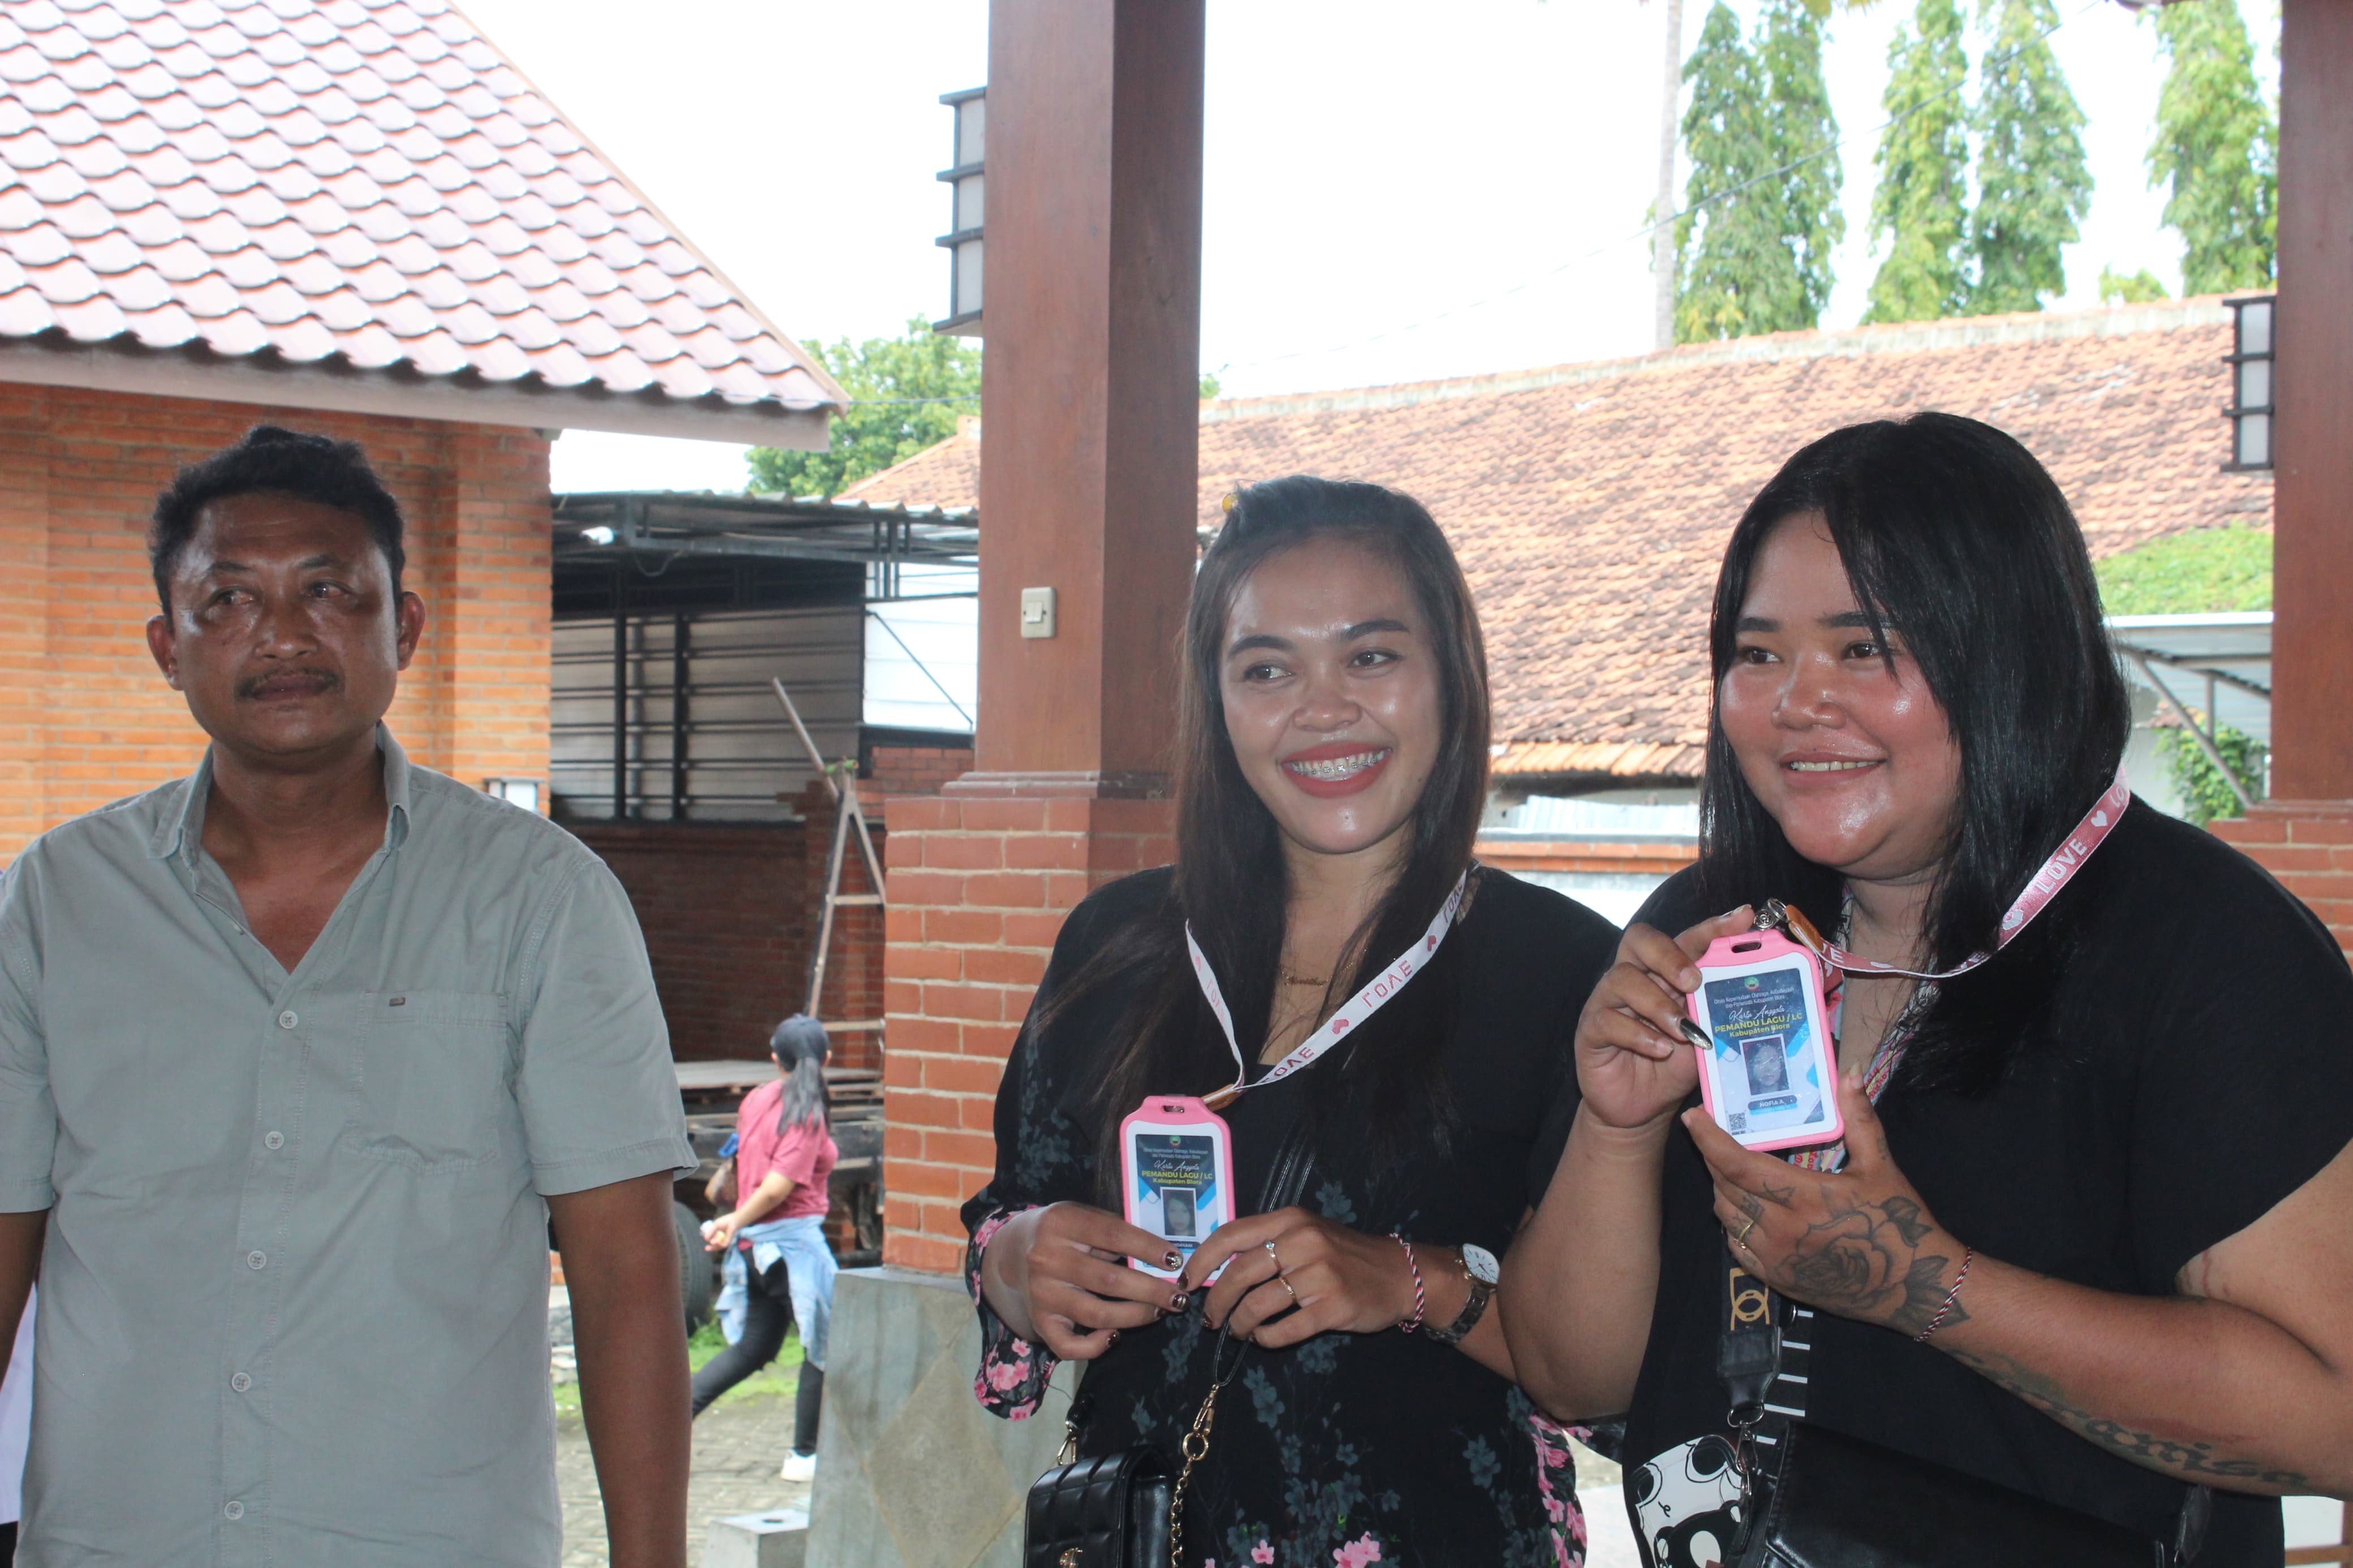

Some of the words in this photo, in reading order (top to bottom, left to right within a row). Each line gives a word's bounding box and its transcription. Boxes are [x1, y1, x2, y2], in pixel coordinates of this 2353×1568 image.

[2036, 838, 2088, 894] LOVE
[1714, 1021, 1760, 1033] PEMANDU
[1761, 1015, 1785, 1026] LAGU
[1787, 1013, 1790, 1022] /
[1730, 1027, 1770, 1038] Kabupaten
